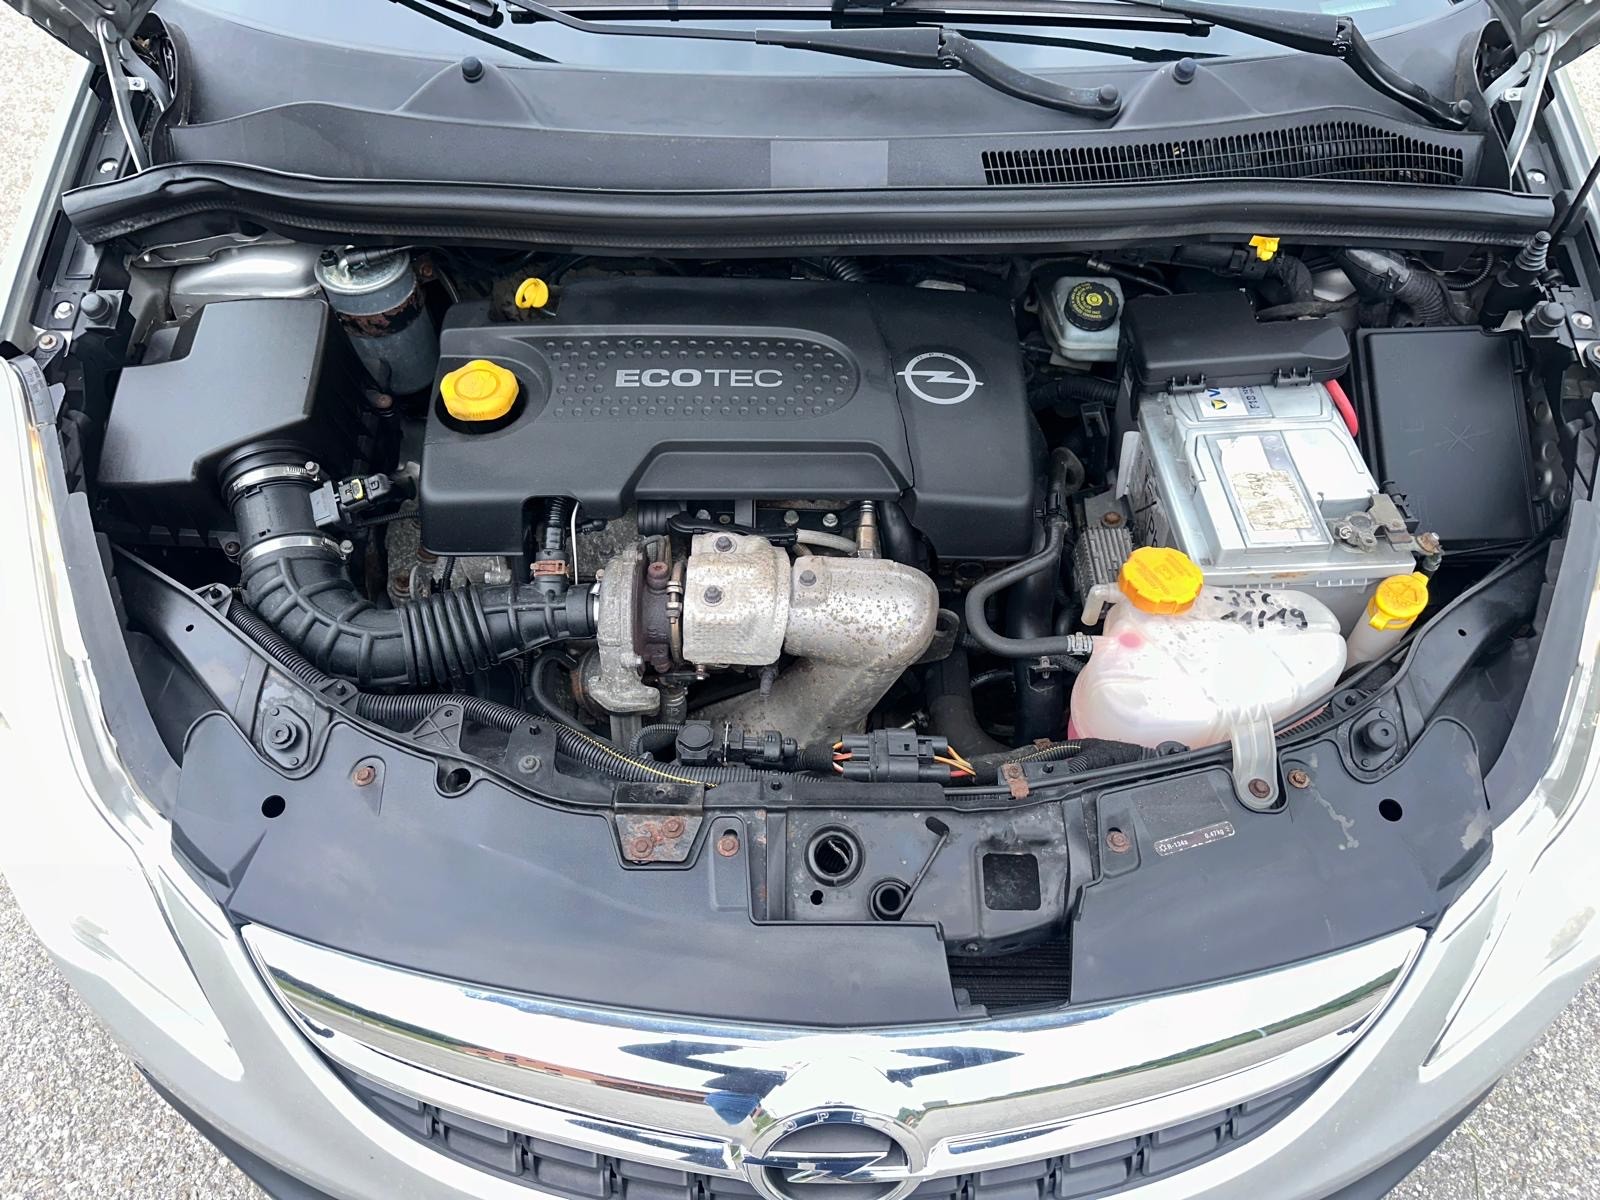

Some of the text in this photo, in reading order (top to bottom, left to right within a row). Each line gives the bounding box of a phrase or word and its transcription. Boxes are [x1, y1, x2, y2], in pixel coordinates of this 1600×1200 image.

[615, 368, 784, 388] ECOTEC
[1220, 607, 1309, 631] 11/19
[782, 1111, 892, 1132] OPEL
